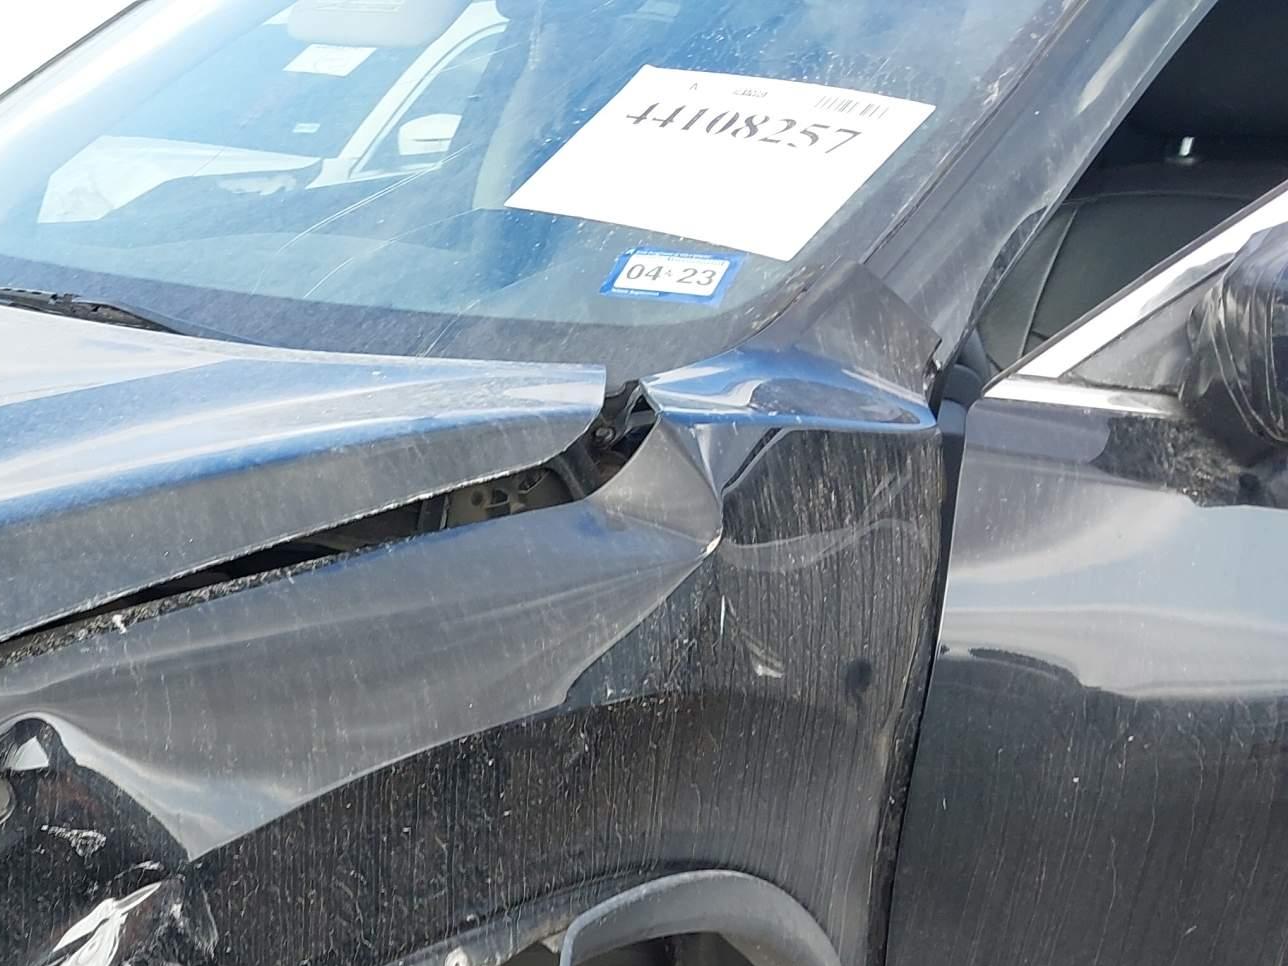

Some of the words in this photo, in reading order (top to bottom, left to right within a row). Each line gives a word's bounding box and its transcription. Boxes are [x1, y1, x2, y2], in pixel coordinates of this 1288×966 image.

[625, 101, 863, 154] 44108257
[625, 263, 664, 281] 04
[675, 267, 718, 287] 23
